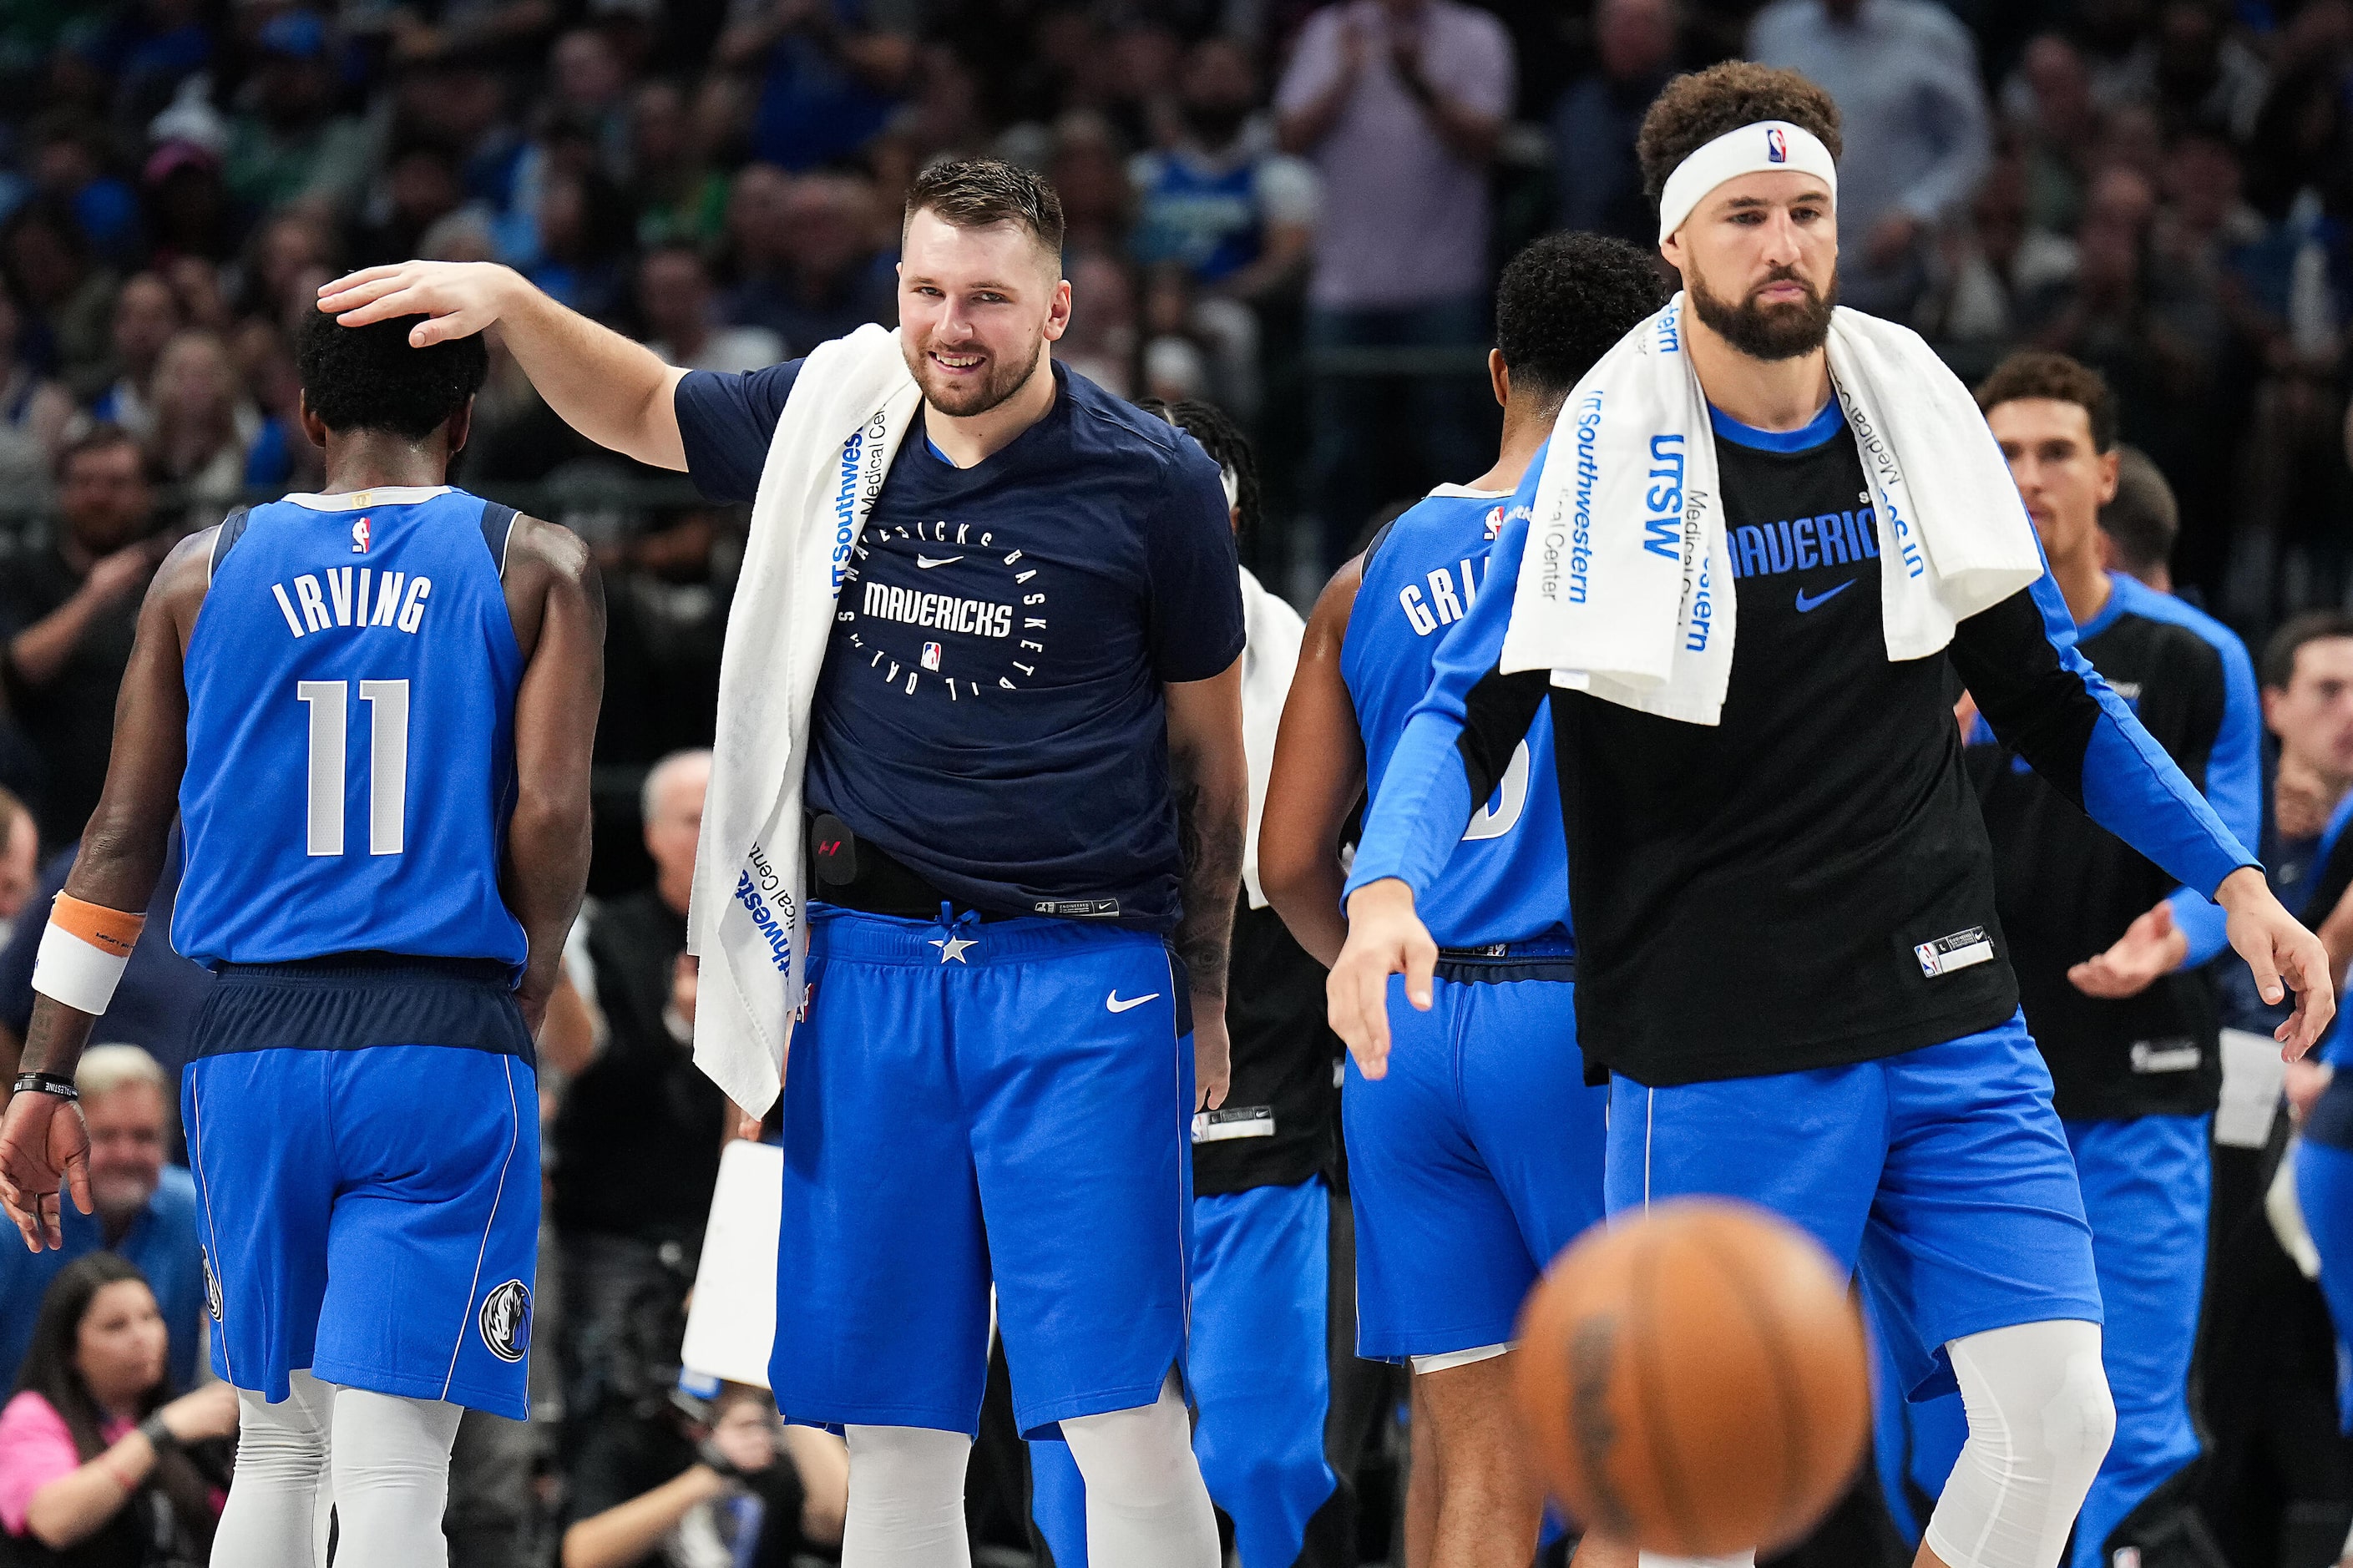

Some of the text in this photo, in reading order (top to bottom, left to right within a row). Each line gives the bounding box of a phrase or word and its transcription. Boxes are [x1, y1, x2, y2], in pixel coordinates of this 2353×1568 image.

[860, 443, 884, 516] Medical
[1642, 433, 1684, 561] UTSW
[271, 566, 432, 639] IRVING
[1399, 556, 1490, 636] GRI
[1542, 532, 1565, 601] Center
[863, 581, 1013, 638] MAVERICKS
[296, 679, 410, 857] 11
[748, 842, 779, 891] Cent
